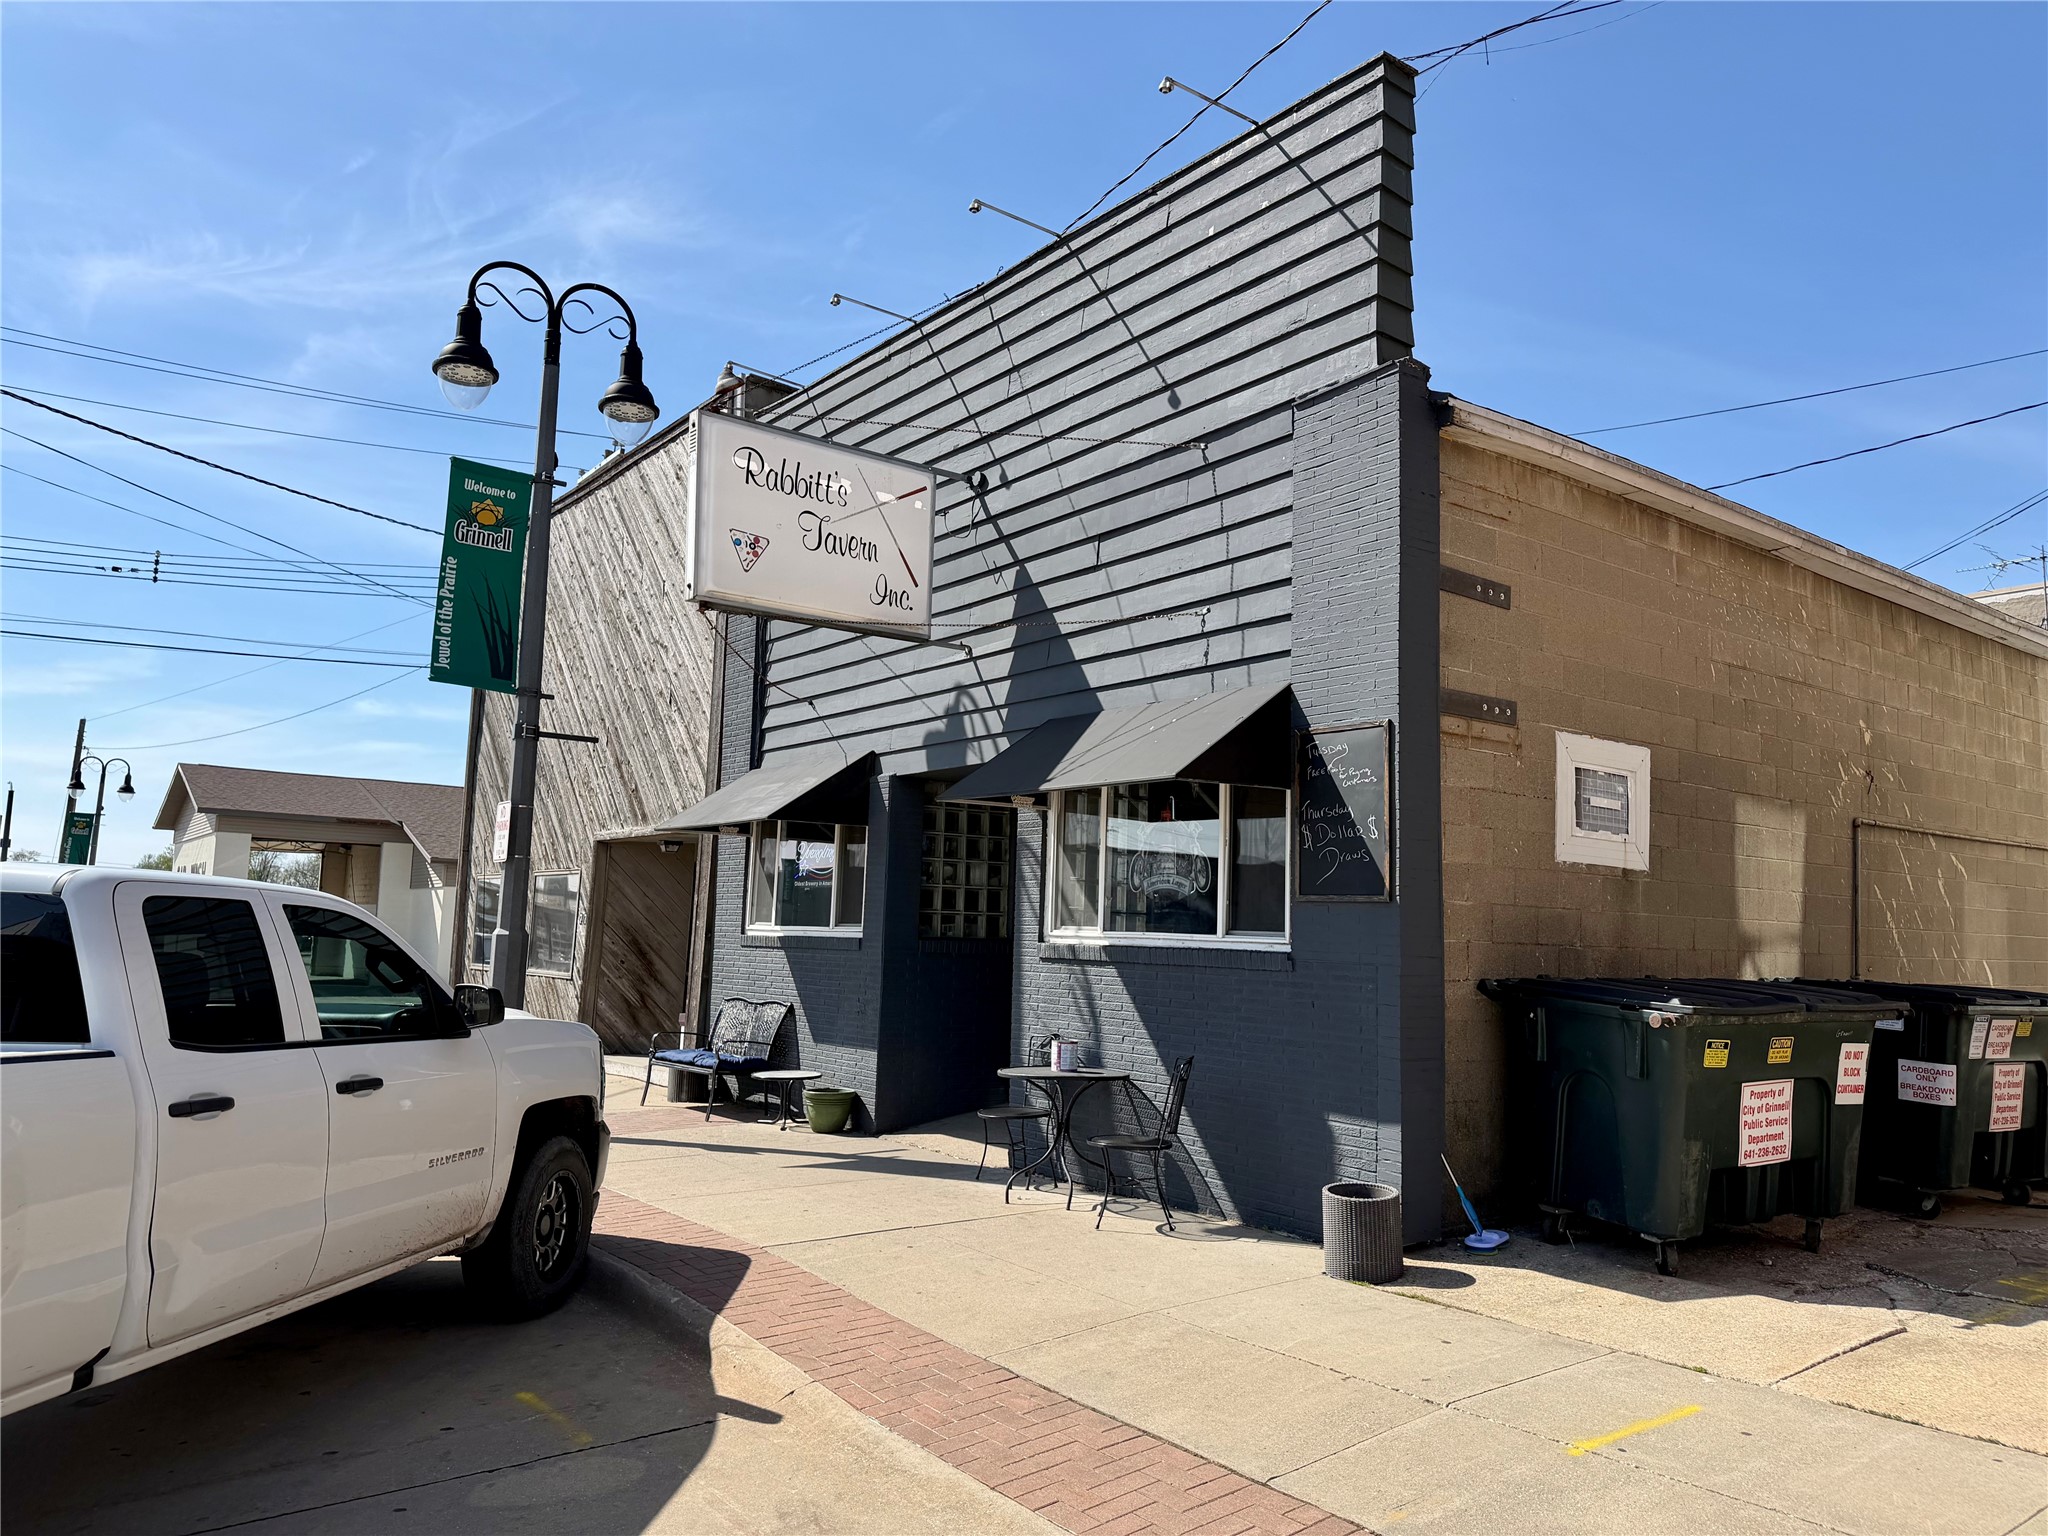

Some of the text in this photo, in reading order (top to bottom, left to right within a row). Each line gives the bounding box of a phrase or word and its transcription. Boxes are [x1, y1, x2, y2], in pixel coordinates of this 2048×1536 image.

[732, 446, 848, 507] Rabbitt's
[464, 478, 516, 500] Welcome to
[454, 519, 514, 552] Grinnell
[797, 510, 879, 563] Tavern
[869, 573, 914, 611] Inc.
[433, 555, 457, 669] Jewel of the Prairie
[1301, 800, 1354, 822] Thursday
[1301, 824, 1313, 851] $
[1367, 814, 1379, 839] $
[1316, 847, 1370, 885] Draws
[1772, 1039, 1791, 1049] CAUTION
[1844, 1050, 1864, 1060] DO NOT
[1843, 1067, 1861, 1077] BLOCK
[1900, 1064, 1954, 1077] CARDBOARD
[1998, 1068, 2015, 1078] Property
[1915, 1073, 1938, 1083] ONLY
[1994, 1080, 2002, 1090] City
[1749, 1086, 1785, 1101] Property of
[1836, 1084, 1865, 1094] CONTAINER
[1900, 1082, 1955, 1095] BREAKDOWN
[1912, 1091, 1941, 1101] BOXES
[1994, 1091, 2021, 1101] Public Service
[1742, 1100, 1790, 1117] City of Grinnell
[1995, 1104, 2018, 1114] Department
[1743, 1116, 1788, 1130] Public Service
[1747, 1131, 1785, 1145] Department
[428, 1147, 485, 1169] SILVERADO
[1743, 1144, 1787, 1160] 641-236-2632
